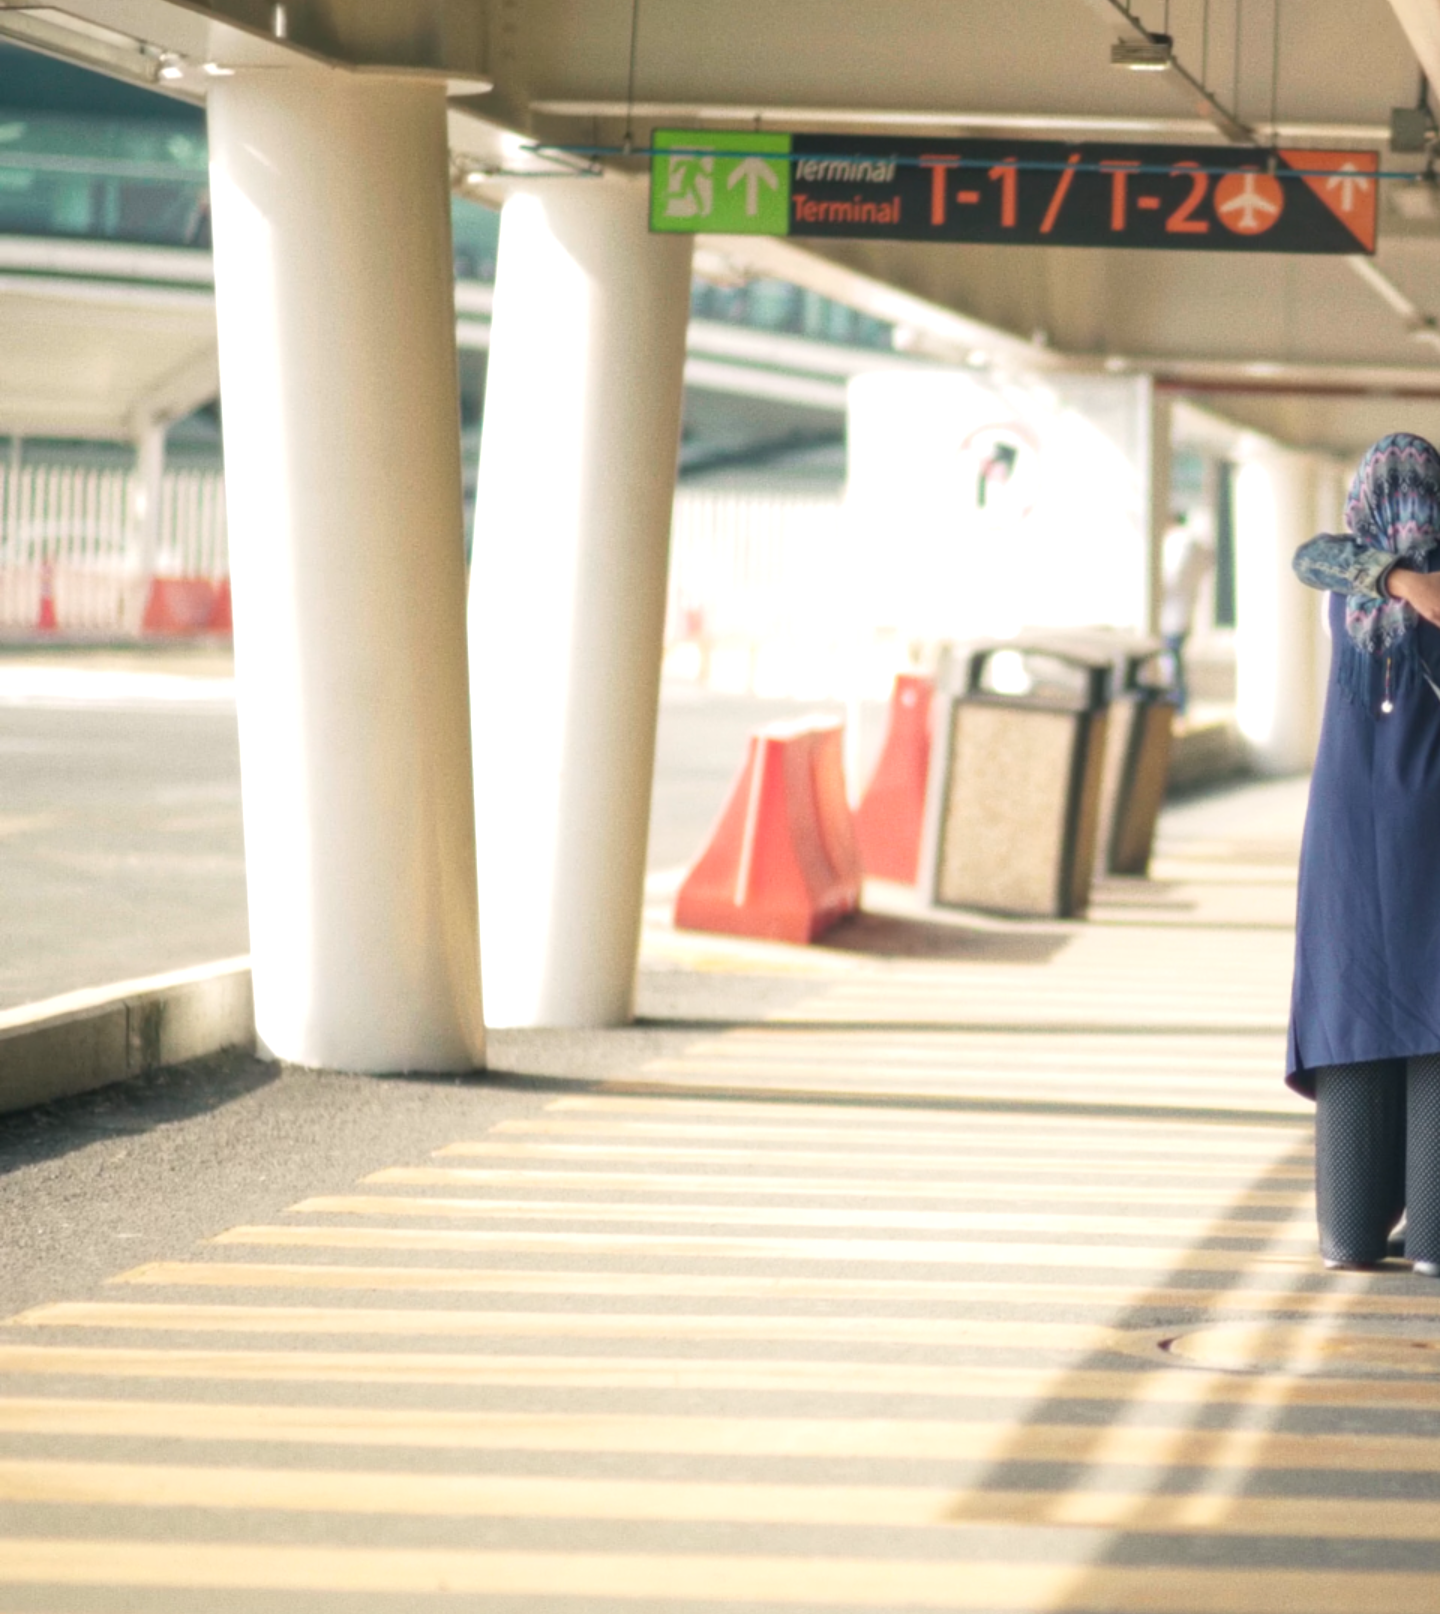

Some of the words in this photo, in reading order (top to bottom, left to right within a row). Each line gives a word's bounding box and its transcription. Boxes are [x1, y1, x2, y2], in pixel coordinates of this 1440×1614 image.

[795, 156, 897, 182] Terminal
[792, 193, 901, 224] Terminal
[918, 154, 1018, 228] T-1
[1039, 152, 1082, 234] /
[1099, 160, 1210, 234] T-2
